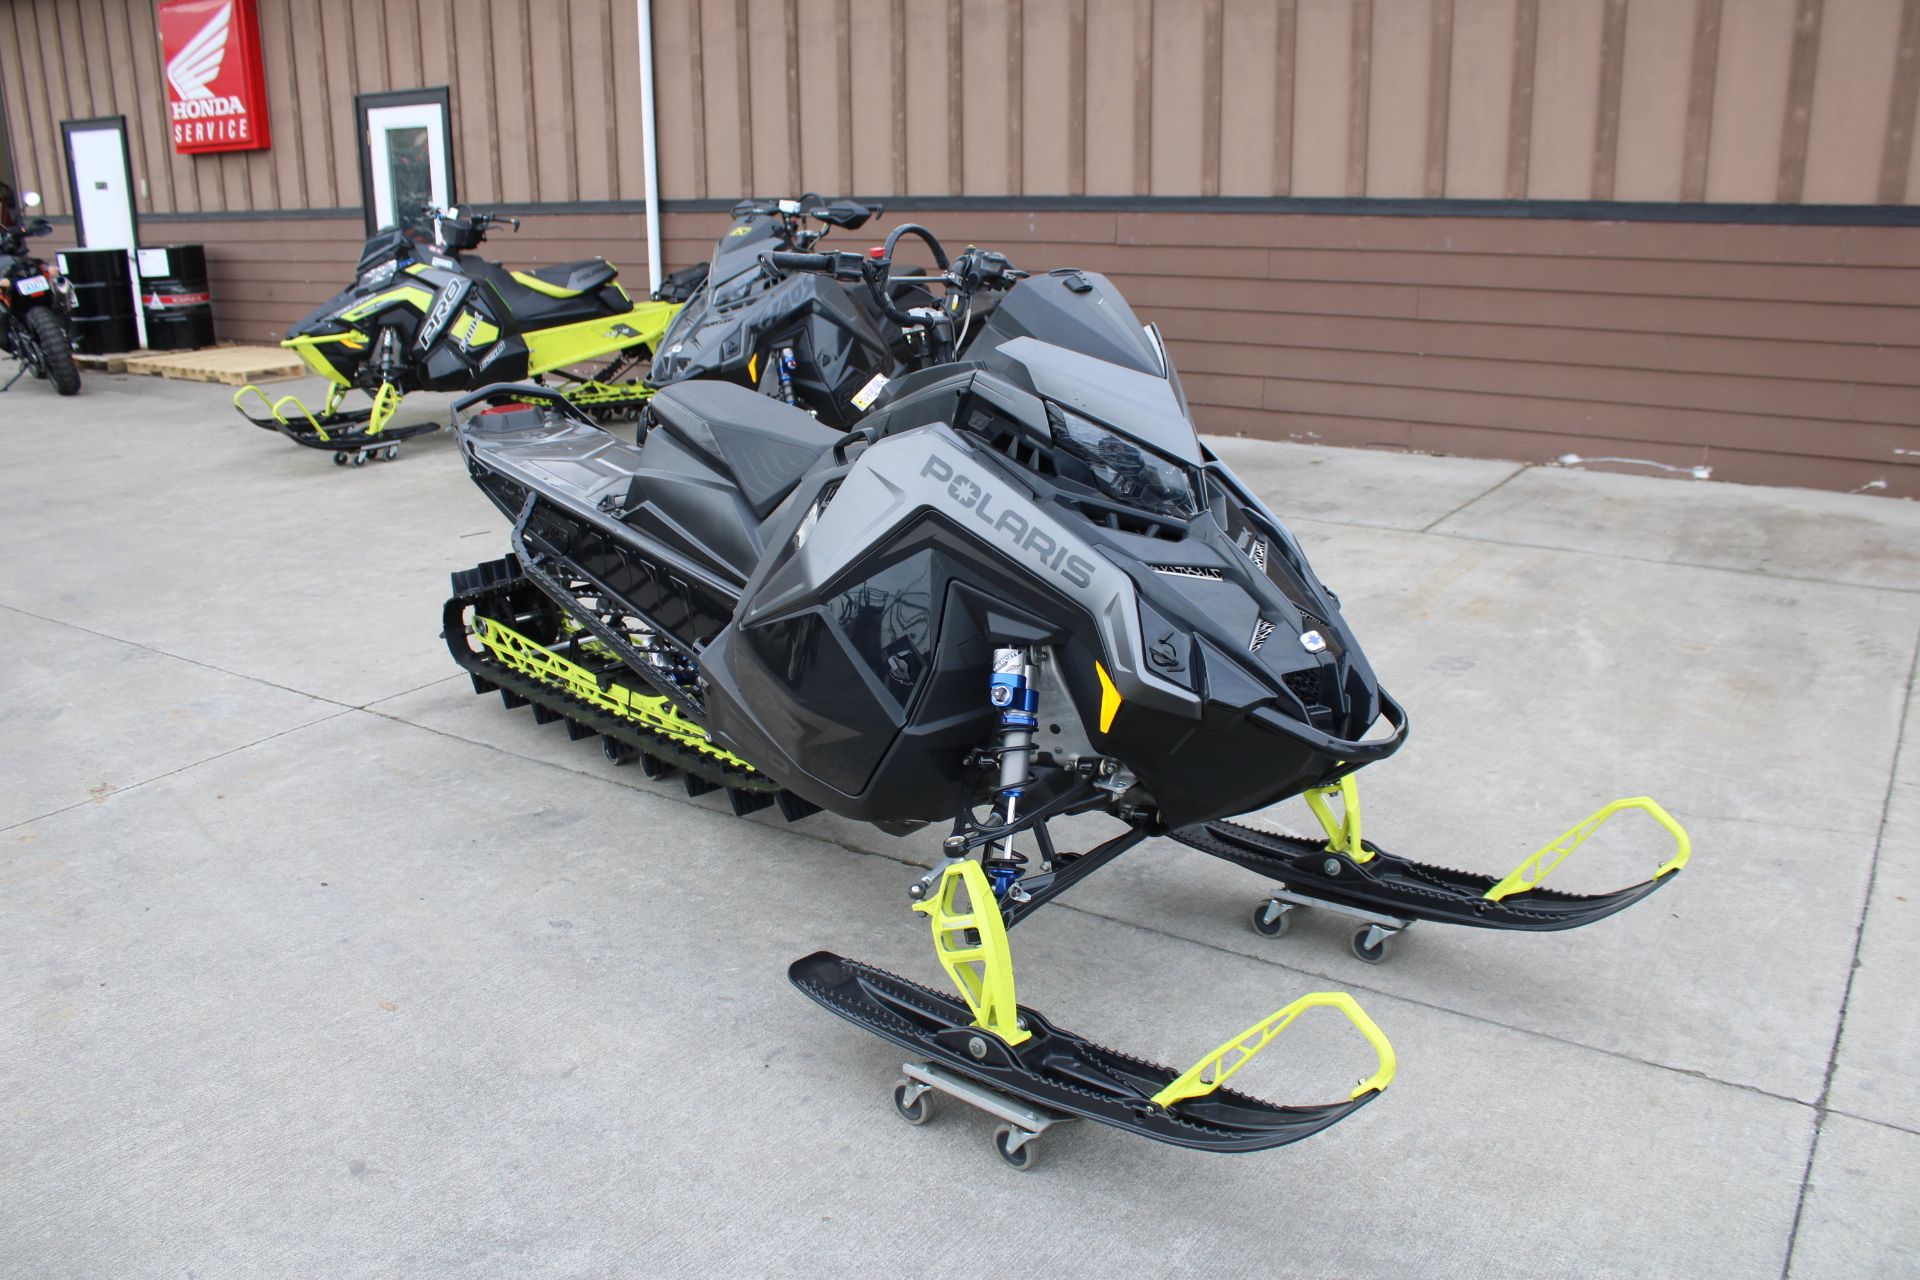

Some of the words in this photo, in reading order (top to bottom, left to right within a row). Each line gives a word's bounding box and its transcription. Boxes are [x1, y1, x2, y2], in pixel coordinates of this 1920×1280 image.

[171, 96, 246, 120] HONDA
[174, 118, 247, 144] SERVICE
[418, 277, 461, 351] PRO
[919, 454, 1096, 589] POLARIS
